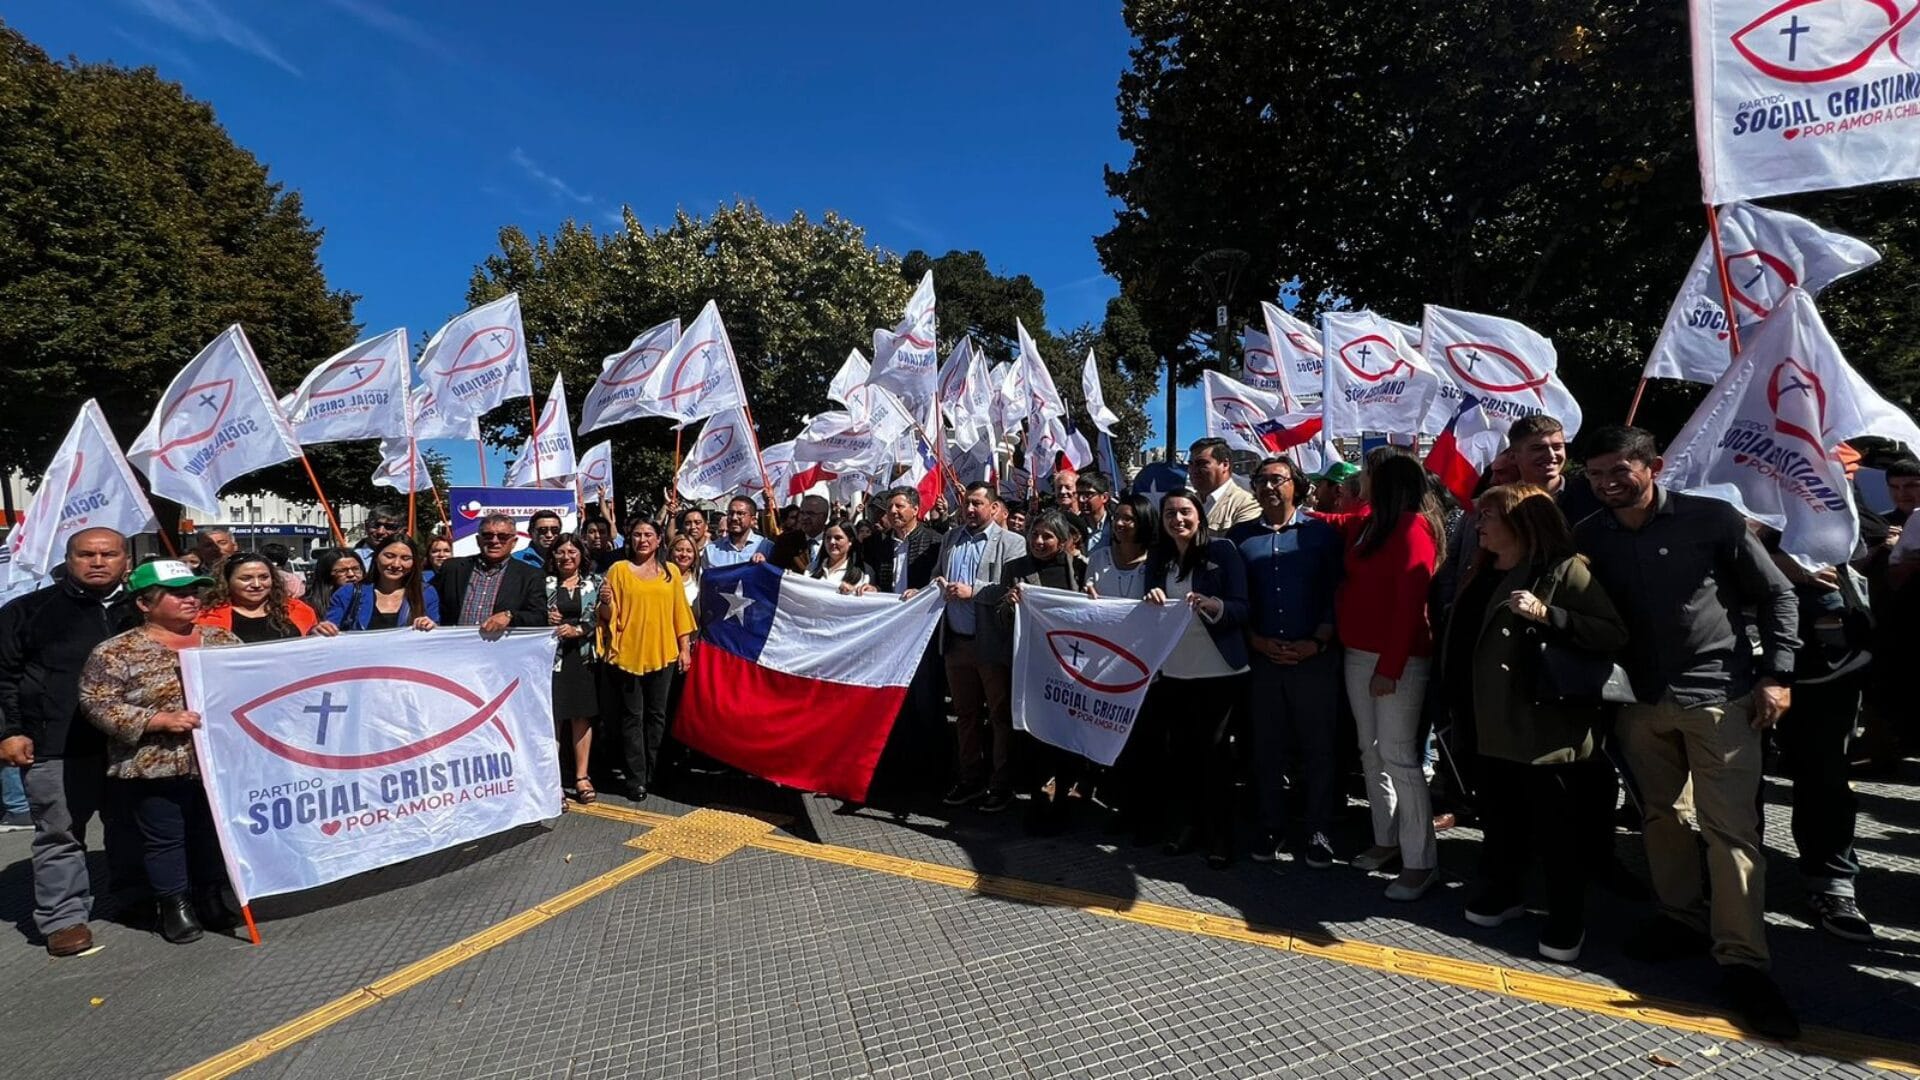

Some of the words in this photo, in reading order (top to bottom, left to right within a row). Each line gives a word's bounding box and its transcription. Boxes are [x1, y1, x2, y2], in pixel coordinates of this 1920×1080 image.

[1738, 94, 1786, 111] PARTIDO
[1733, 99, 1820, 136] SOCIAL
[1802, 122, 1835, 138] POR
[1838, 109, 1884, 132] AMOR
[1885, 108, 1893, 121] A
[1481, 396, 1543, 417] CRISTIANO
[1046, 678, 1074, 690] PARTIDO
[1044, 684, 1088, 711] SOCIAL
[1076, 711, 1094, 723] POR
[248, 782, 369, 836] SOCIAL
[380, 752, 514, 804] CRISTIANO
[249, 777, 323, 802] PARTIDO
[346, 810, 390, 831] POR
[396, 792, 455, 818] AMOR
[459, 790, 472, 803] A
[473, 779, 515, 799] CHILE
